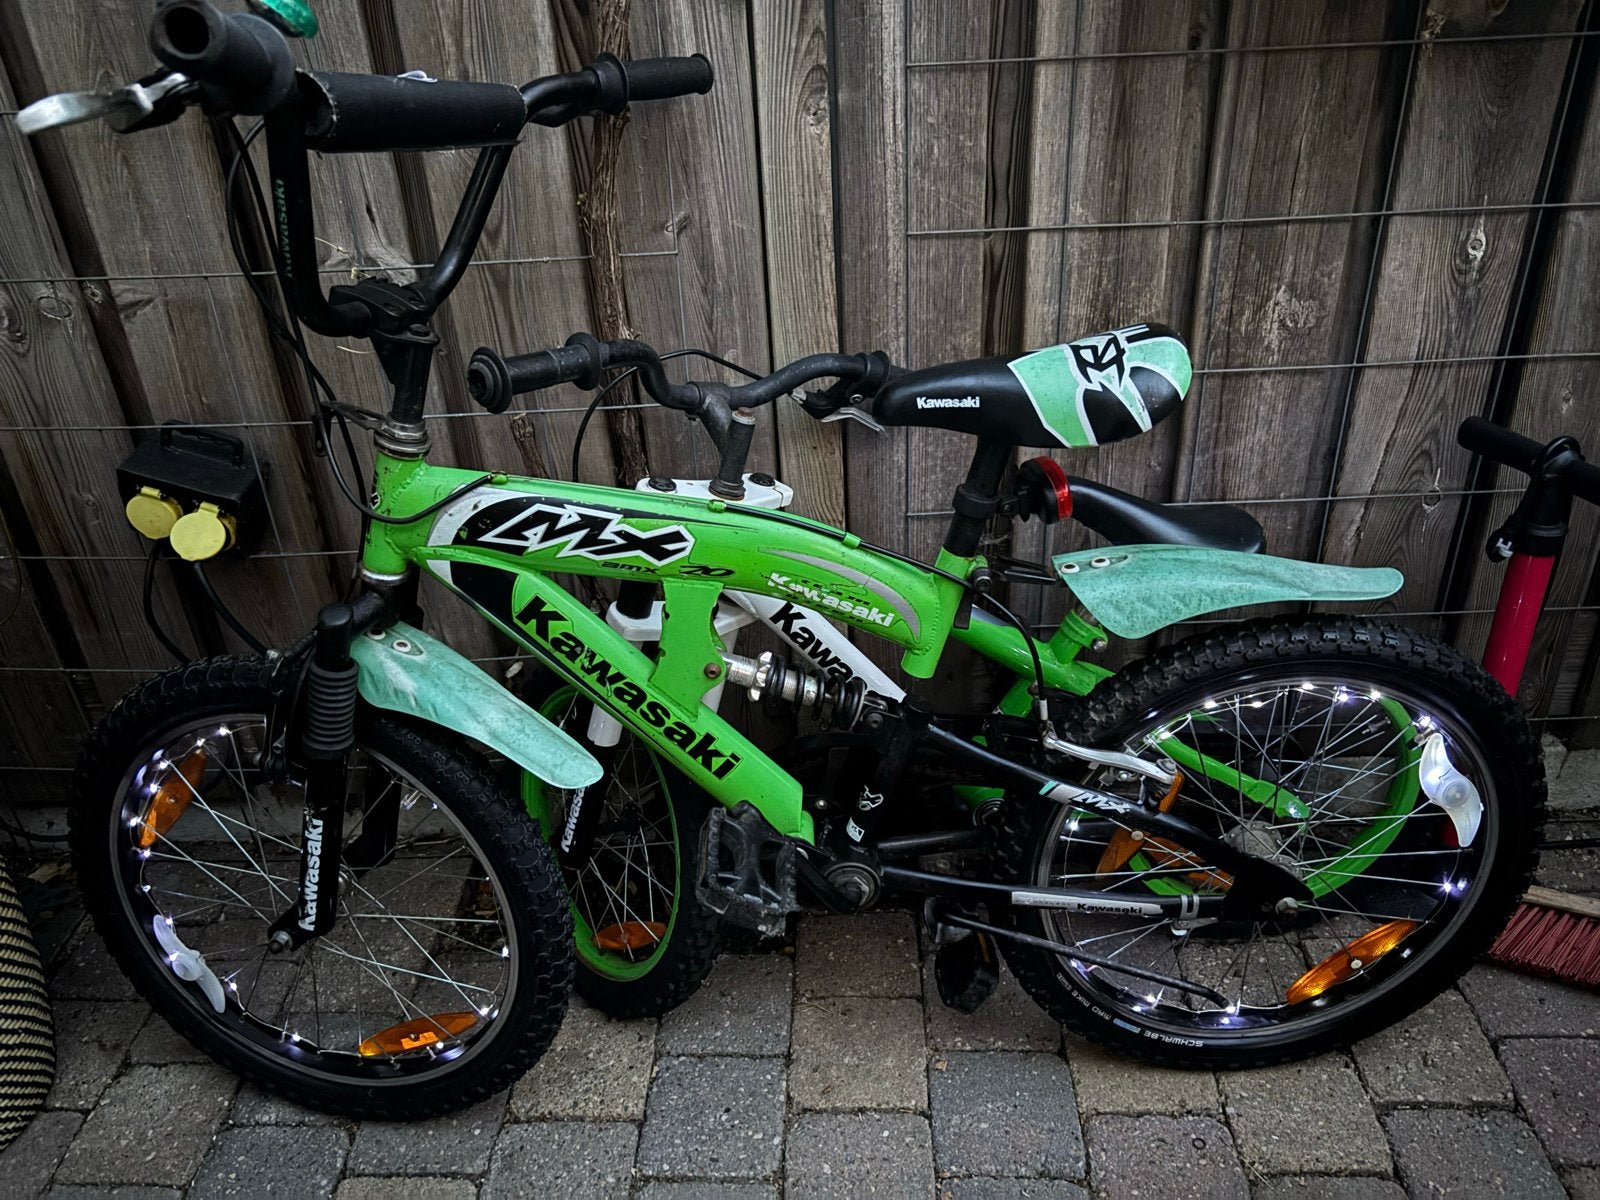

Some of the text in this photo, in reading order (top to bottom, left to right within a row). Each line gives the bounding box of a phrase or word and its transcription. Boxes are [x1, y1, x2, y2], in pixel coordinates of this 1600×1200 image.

[916, 396, 981, 409] Kawasaki
[477, 503, 696, 567] MX
[766, 572, 895, 628] Kawasaki
[768, 601, 868, 690] Kawa
[514, 595, 741, 781] Kawasaki
[560, 785, 588, 853] Kawasa
[298, 818, 324, 931] Kawasaki
[1076, 903, 1143, 915] Kawasaki
[1071, 988, 1204, 1048] SCHWALBE MAD MIKE
